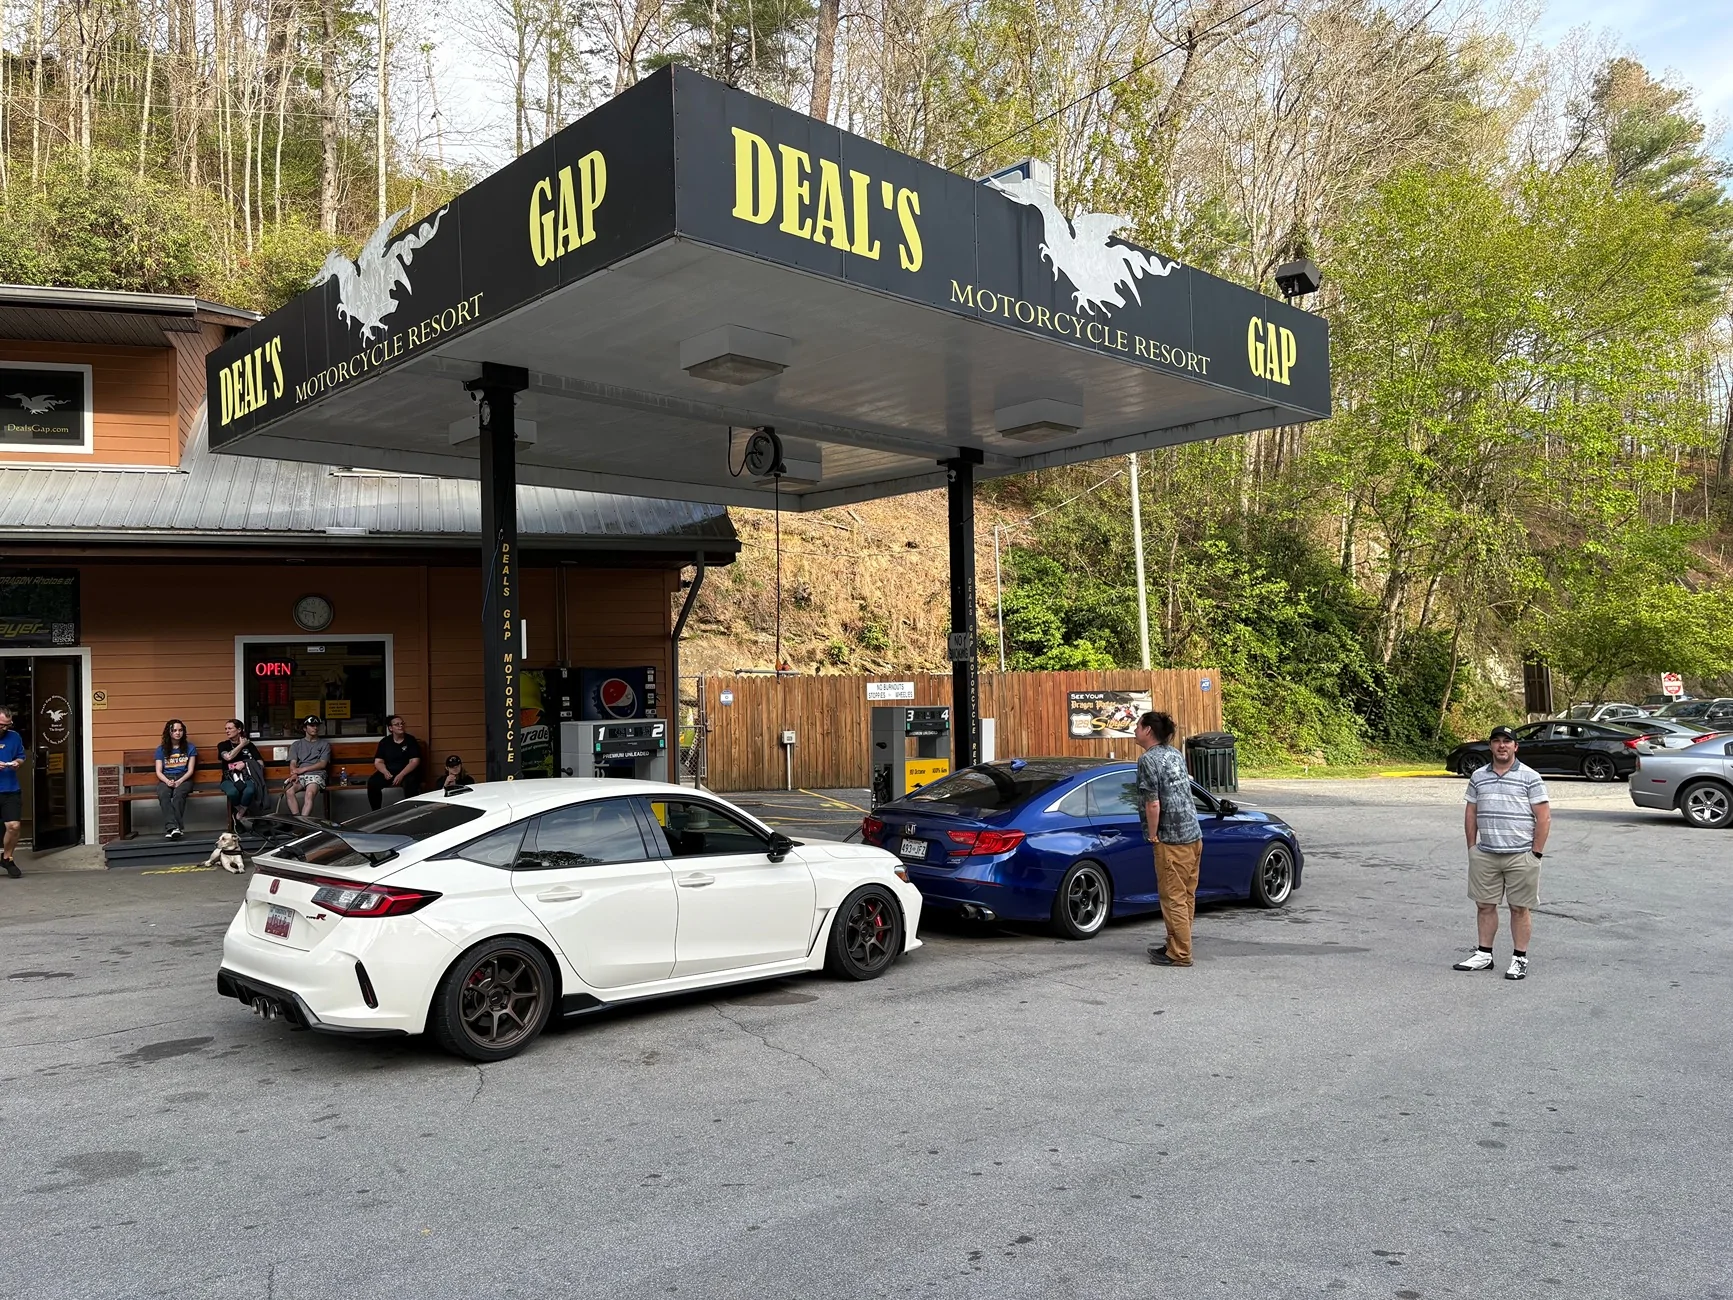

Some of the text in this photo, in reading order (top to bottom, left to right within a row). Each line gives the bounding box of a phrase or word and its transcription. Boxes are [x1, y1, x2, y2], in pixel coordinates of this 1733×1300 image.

[529, 150, 607, 267] GAP
[731, 126, 923, 273] DEAL'S
[295, 292, 484, 404] MOTORCYCLE RESORT
[950, 279, 1211, 375] MOTORCYCLE RESORT
[1247, 316, 1297, 386] GAP
[219, 335, 284, 427] DEAL'S
[7, 423, 69, 434] DealsGap.com
[255, 662, 291, 676] OPEN
[502, 543, 515, 762] DEALS GAP MOTORCYCLE
[954, 635, 963, 646] NO
[906, 709, 949, 721] 3 4
[969, 656, 977, 734] MOTORCYCLE
[520, 726, 549, 743] rade
[598, 724, 664, 741] 1 2
